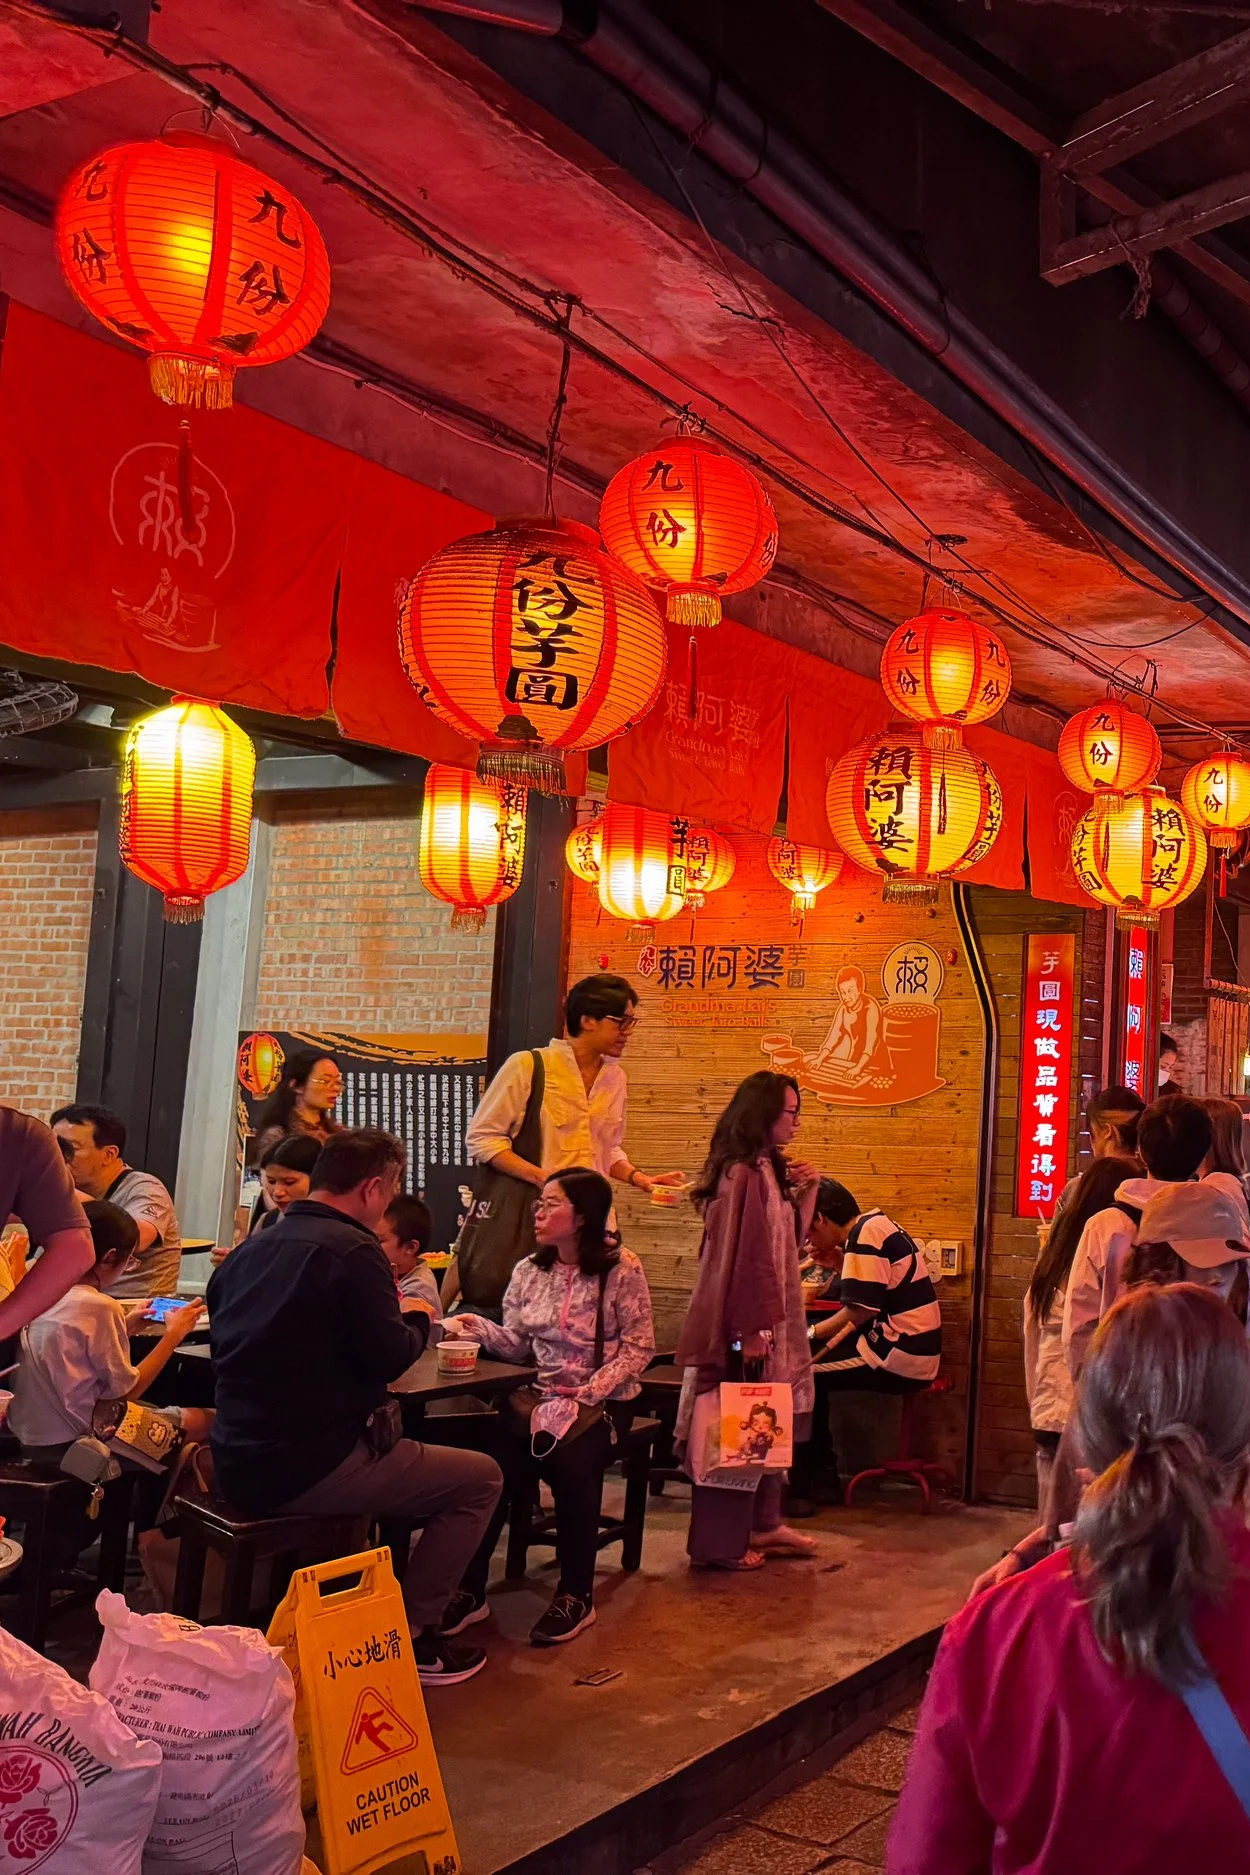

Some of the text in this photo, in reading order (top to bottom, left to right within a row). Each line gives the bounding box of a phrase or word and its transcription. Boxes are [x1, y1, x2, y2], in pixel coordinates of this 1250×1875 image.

[72, 161, 111, 284] 九份
[234, 188, 303, 317] 九份
[641, 460, 687, 549] 九份
[505, 553, 595, 711] 九份芋圓
[895, 628, 920, 697] 九份
[983, 639, 1007, 708] 九份
[1089, 712, 1116, 767] 九份
[865, 746, 915, 853] 賴阿婆
[1203, 767, 1224, 813] 九份
[494, 782, 525, 889] 賴阿婆
[665, 815, 690, 896] 芋圓
[1150, 807, 1187, 892] 賴阿婆
[639, 945, 806, 990] 九份 賴阿婆 芋圓
[661, 997, 777, 1015] Grandma Lai's
[741, 1016, 770, 1028] Balls
[324, 1628, 402, 1681] 小心地滑
[34, 1718, 113, 1789] BANGNA
[204, 1727, 237, 1740] COMPANY
[346, 1787, 431, 1836] WET FLOOR
[355, 1771, 420, 1811] CAUTION
